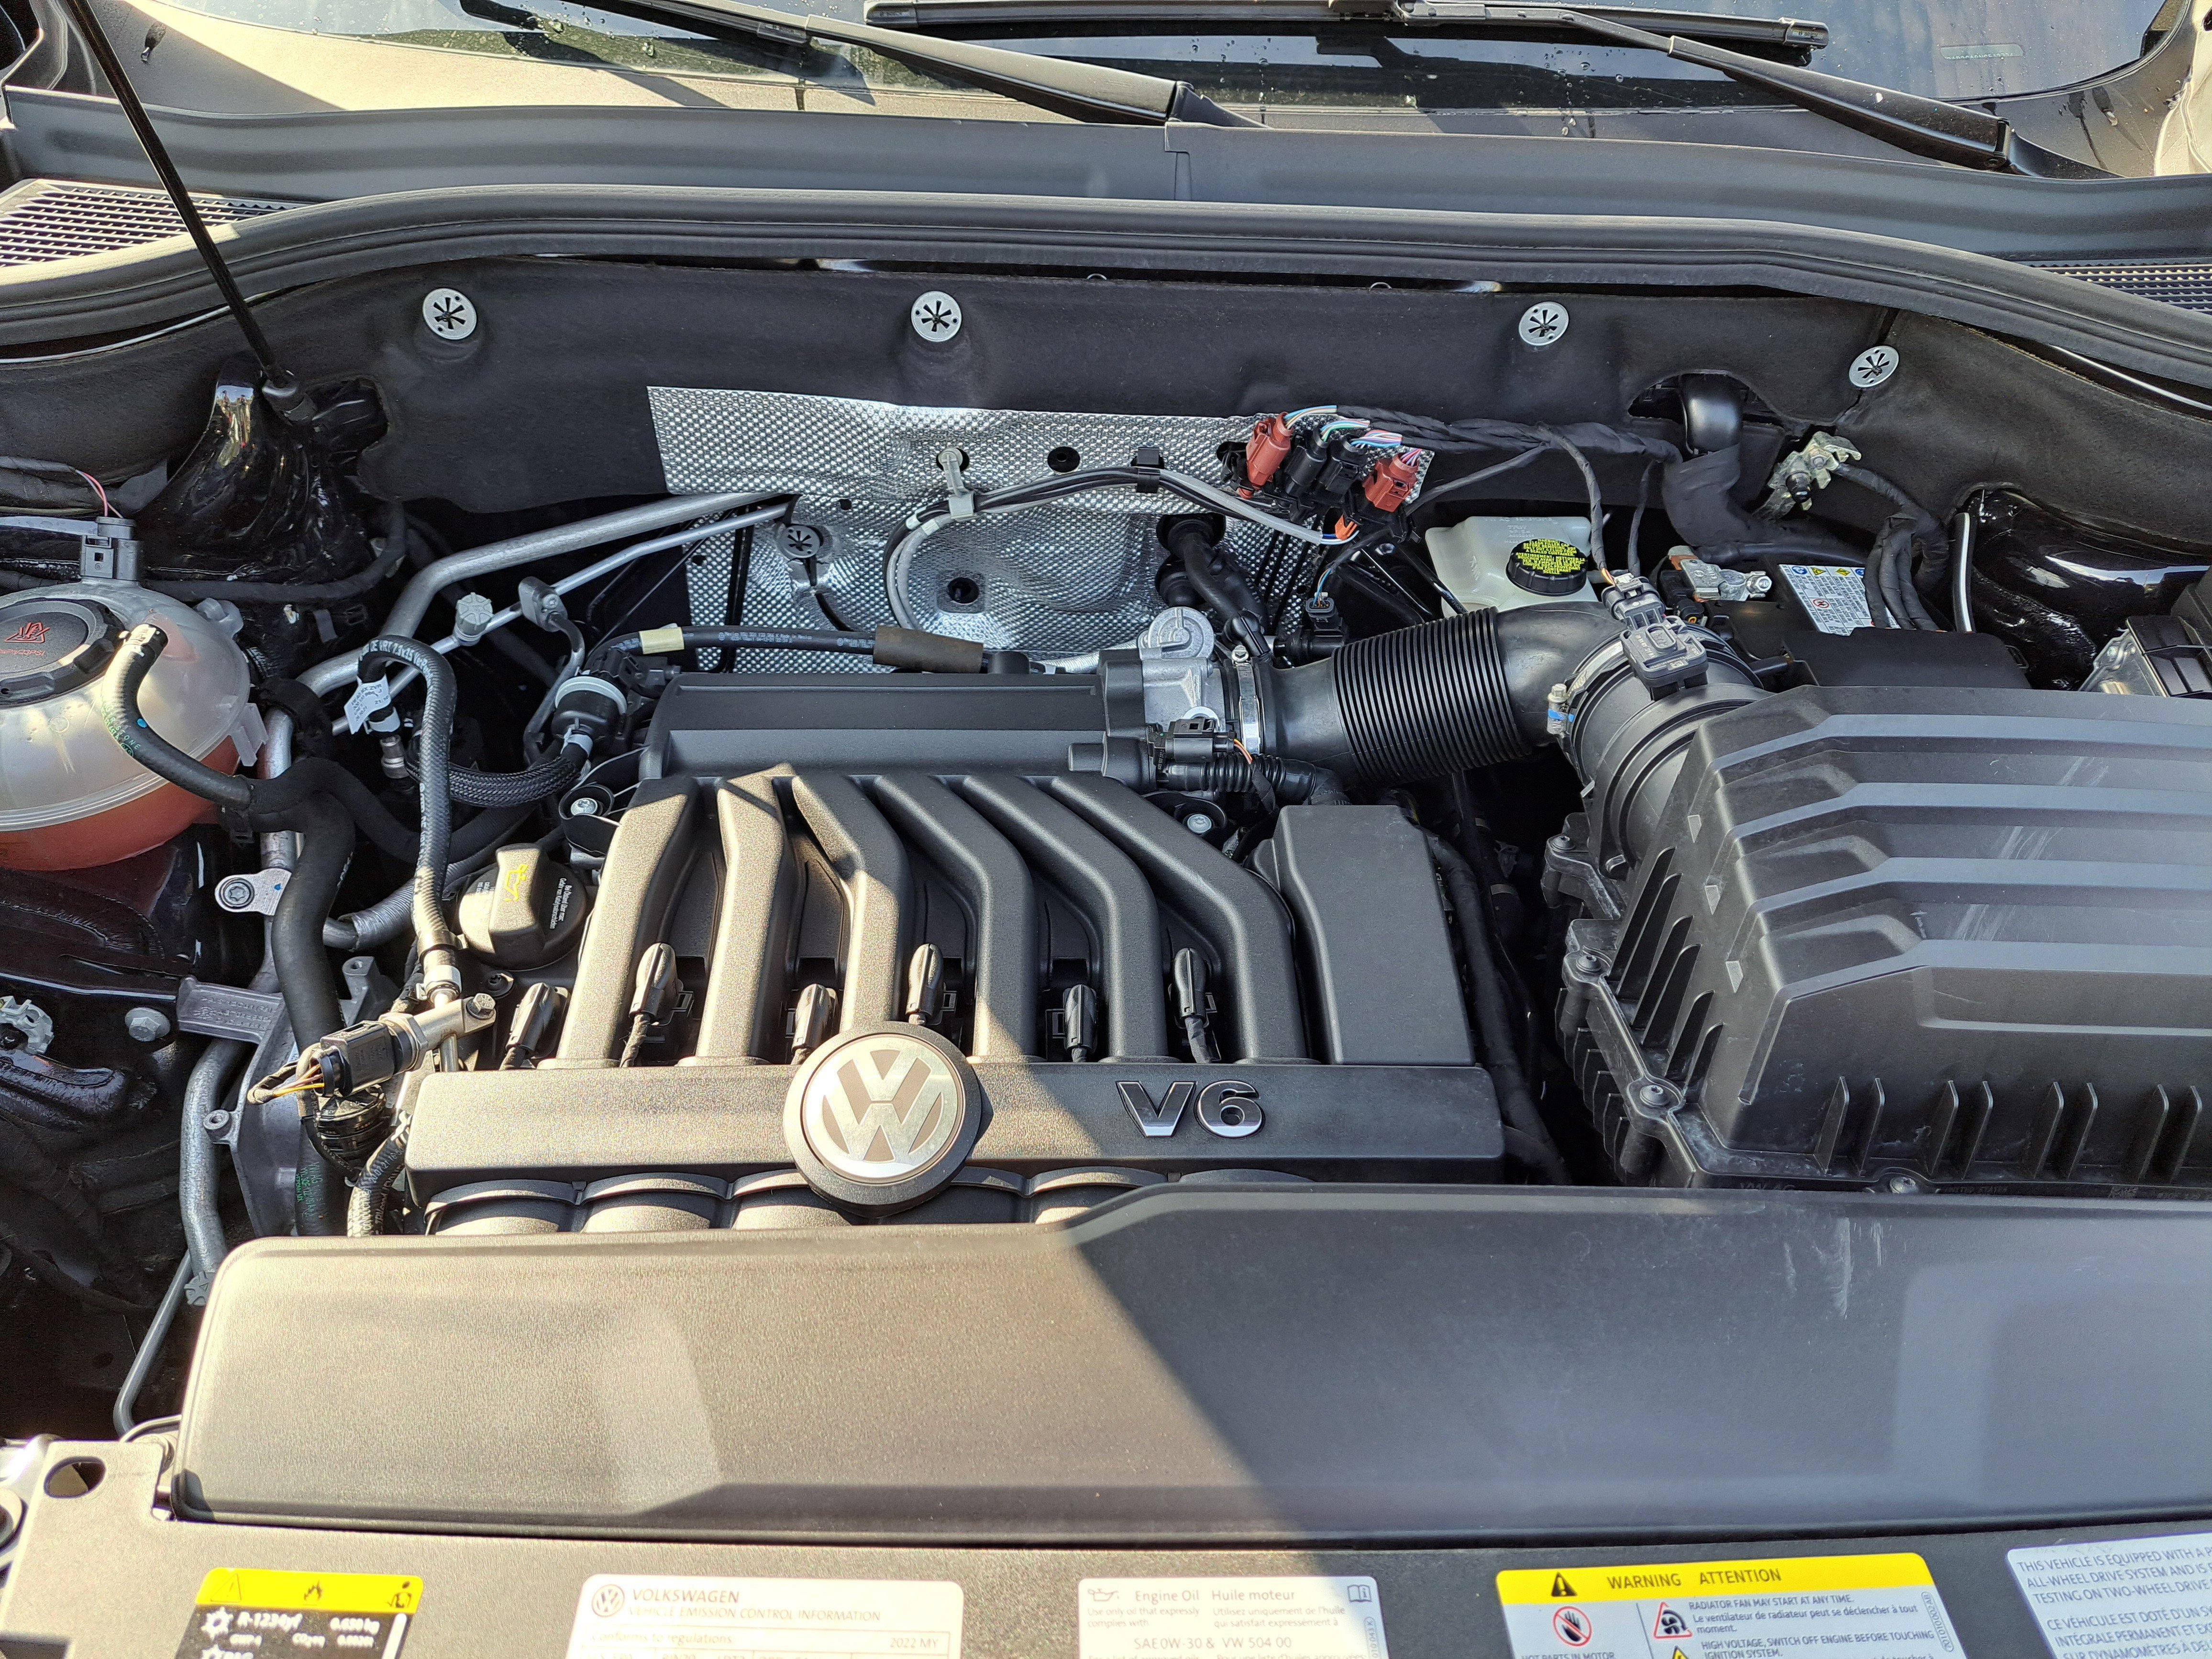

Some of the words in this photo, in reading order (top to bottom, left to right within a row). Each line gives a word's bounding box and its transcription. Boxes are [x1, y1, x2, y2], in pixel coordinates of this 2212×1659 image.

[1116, 1079, 1265, 1139] V6
[2016, 1560, 2045, 1572] THIS
[2044, 1556, 2092, 1570] VEHICLE
[2093, 1555, 2105, 1566] IS
[2105, 1551, 2162, 1567] EQUIPPED
[2162, 1548, 2194, 1561] WITH
[2195, 1548, 2205, 1558] A
[1607, 1573, 1681, 1589] WARNING
[1699, 1568, 1782, 1585] ATTENTION
[2027, 1573, 2090, 1588] ALL-WHEEL
[2089, 1570, 2124, 1582] DRIVE
[2125, 1567, 2168, 1580] SYSTEM
[2169, 1564, 2195, 1576] AND
[2195, 1563, 2207, 1574] IS
[633, 1589, 740, 1604] VOLKSWAGEN
[1135, 1590, 1178, 1605] Engine
[1182, 1589, 1200, 1601] Oil
[1212, 1590, 1245, 1601] Huile
[1249, 1591, 1295, 1601] moteur
[2033, 1590, 2082, 1604] TESTING
[2083, 1588, 2102, 1600] ON
[2101, 1582, 2176, 1598] TWO-WHEEL
[2175, 1579, 2211, 1592] DRIVE
[1689, 1600, 1732, 1610] RADIATOR
[1734, 1599, 1752, 1608] FAN
[1753, 1597, 1771, 1607] MAY
[1772, 1596, 1799, 1606] START
[1801, 1596, 1810, 1604] AT
[1812, 1595, 1829, 1604] ANY
[1830, 1593, 1855, 1604] TIME.
[680, 1607, 736, 1618] EMISSION
[740, 1608, 793, 1620] CONTROL
[798, 1609, 881, 1621] INFORMATION
[1106, 1607, 1124, 1617] only
[1127, 1607, 1137, 1615] oil
[1139, 1607, 1157, 1615] that
[1160, 1607, 1200, 1617] expressly
[1213, 1607, 1245, 1616] Utilisez
[1248, 1607, 1303, 1617] uniquement
[1306, 1607, 1317, 1615] de
[1692, 1614, 1704, 1623] Le
[1705, 1612, 1753, 1622] ventilateur
[1755, 1611, 1767, 1620] de
[1769, 1609, 1808, 1619] radiateur
[1809, 1609, 1830, 1619] peut
[1843, 1604, 1890, 1616] déclencher
[1891, 1604, 1898, 1614] à
[1899, 1604, 1919, 1613] tout
[2047, 1618, 2063, 1631] CE
[2062, 1614, 2118, 1629] VÉHICULE
[2117, 1612, 2138, 1624] EST
[2138, 1607, 2170, 1622] DOTÉ
[2170, 1607, 2201, 1620] D'UN
[238, 1612, 303, 1632] R-1234yf
[1087, 1619, 1127, 1629] complies
[1129, 1619, 1149, 1627] with
[1214, 1619, 1228, 1629] qui
[1230, 1619, 1265, 1627] satisfait
[1268, 1618, 1331, 1629] expressément
[1333, 1618, 1338, 1626] à
[890, 1637, 917, 1649] 2022
[920, 1638, 939, 1649] MY
[1205, 1637, 1215, 1649] &
[1222, 1637, 1244, 1648] VW
[1248, 1636, 1272, 1649] 504
[1275, 1636, 1293, 1649] 00
[1701, 1640, 1724, 1650] HIGH
[1724, 1638, 1767, 1649] VOLTAGE,
[1766, 1636, 1802, 1647] SWITCH
[1802, 1635, 1820, 1645] OFF
[1820, 1633, 1854, 1644] ENGINE
[1854, 1631, 1890, 1643] BEFORE
[1889, 1628, 1935, 1641] TOUCHING
[2055, 1632, 2116, 1648] INTÉGRALE
[2114, 1626, 2181, 1642] PERMANENT
[2181, 1624, 2195, 1636] ET
[1704, 1650, 1746, 1659] IGNITION
[1746, 1648, 1783, 1659] SYSTEM.
